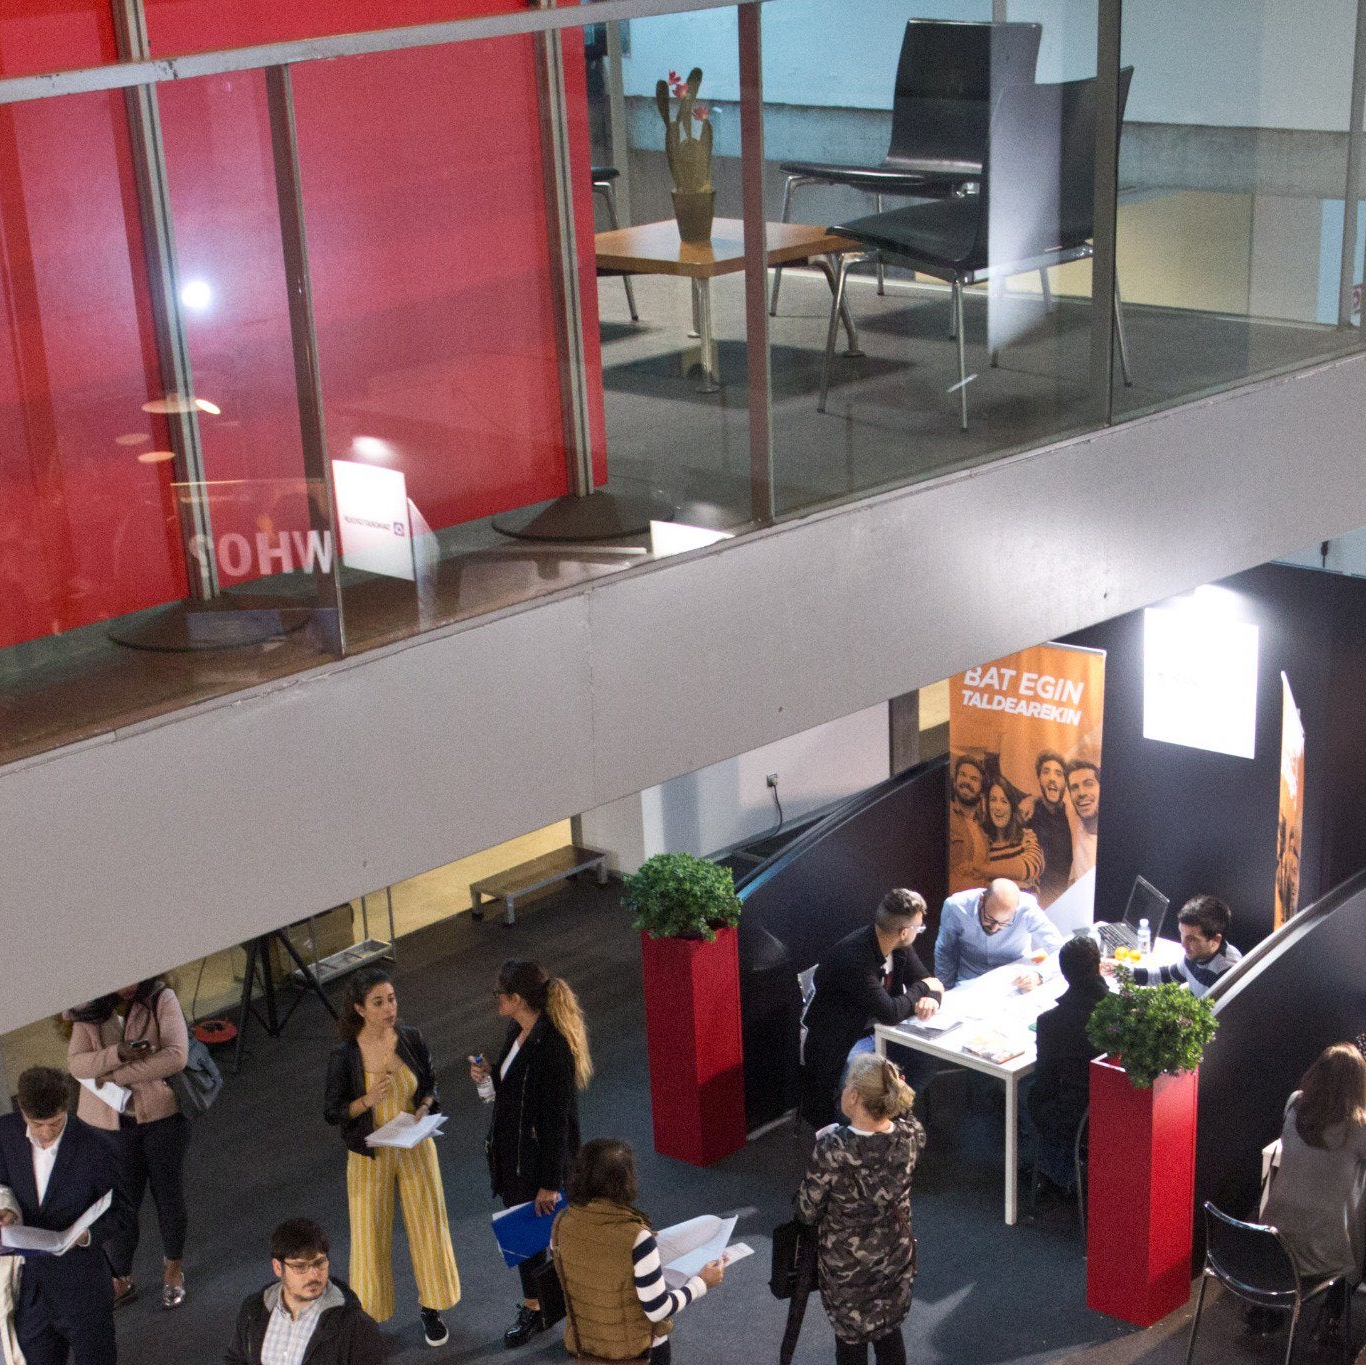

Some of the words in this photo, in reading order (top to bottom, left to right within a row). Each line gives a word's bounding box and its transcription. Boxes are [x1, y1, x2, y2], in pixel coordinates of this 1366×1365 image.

[964, 666, 1017, 691] BAT
[1019, 671, 1084, 706] EGIN
[961, 689, 1083, 727] TALDEAREKIN
